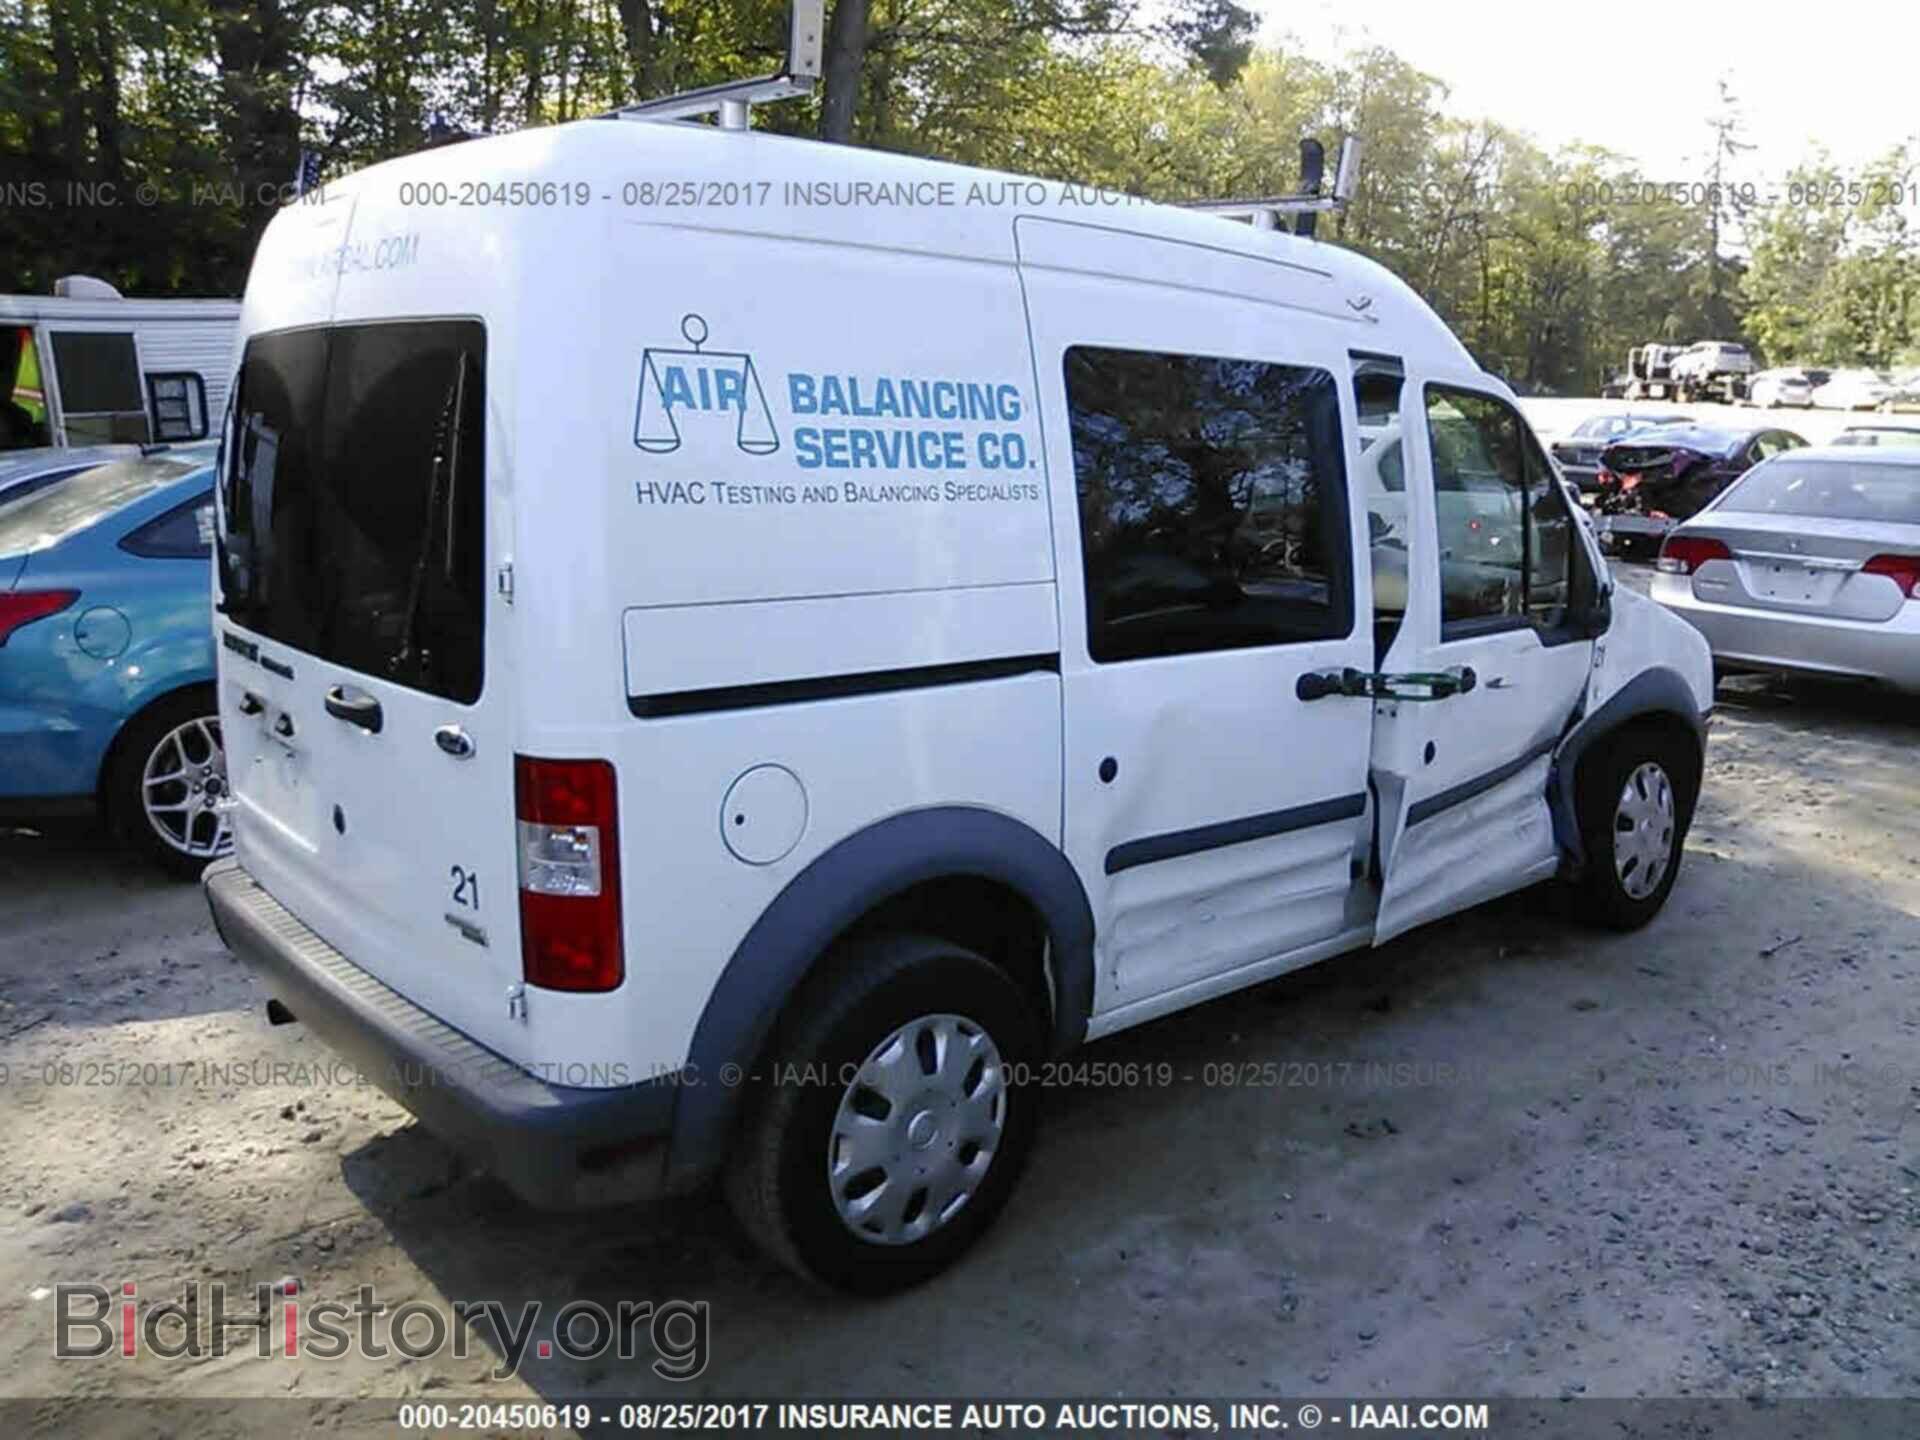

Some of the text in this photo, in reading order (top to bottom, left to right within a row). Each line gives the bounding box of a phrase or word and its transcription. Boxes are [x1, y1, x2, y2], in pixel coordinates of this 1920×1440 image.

[661, 366, 747, 411] AIR
[787, 373, 1021, 421] BALANCING
[793, 427, 1036, 469] SERVICE CO.
[636, 481, 1039, 505] HVAC TESTING AND BALANCING SPECIALISTS
[451, 864, 479, 910] 21
